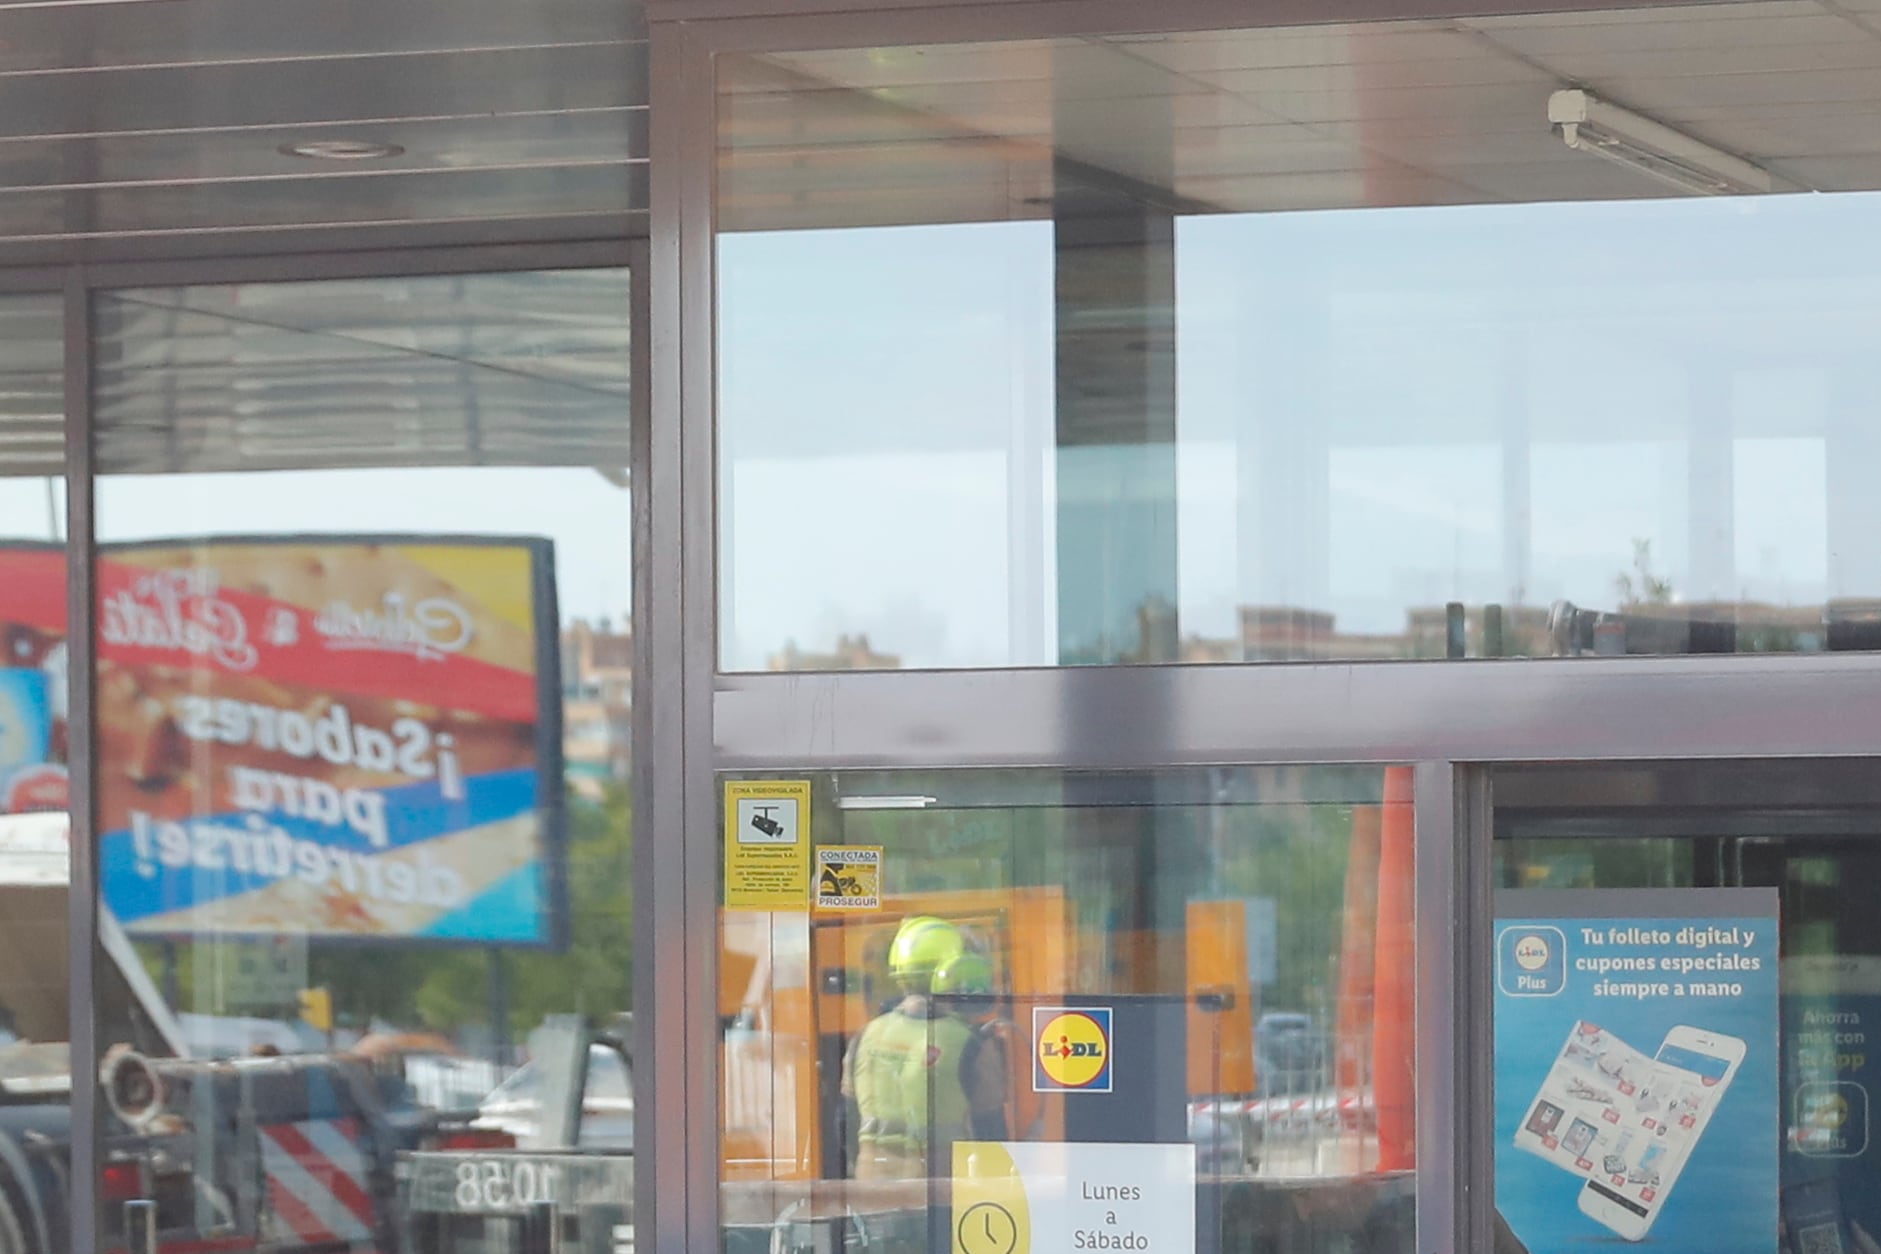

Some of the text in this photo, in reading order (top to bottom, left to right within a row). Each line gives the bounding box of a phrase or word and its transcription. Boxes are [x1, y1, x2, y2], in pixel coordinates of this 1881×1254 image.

[819, 851, 878, 860] CONECTADA
[819, 897, 877, 906] PROSEGUR
[1581, 927, 1755, 948] Tu folleto digital y
[1576, 952, 1761, 976] cupones especiales
[1517, 976, 1547, 990] Plus
[1594, 979, 1742, 1000] siempre a mano
[1803, 1009, 1860, 1025] Ahorra
[1797, 1029, 1866, 1045] más con
[1822, 1050, 1866, 1071] App
[1082, 1180, 1141, 1201] Lunes
[1105, 1211, 1117, 1226] a
[1074, 1229, 1149, 1251] Sábado
